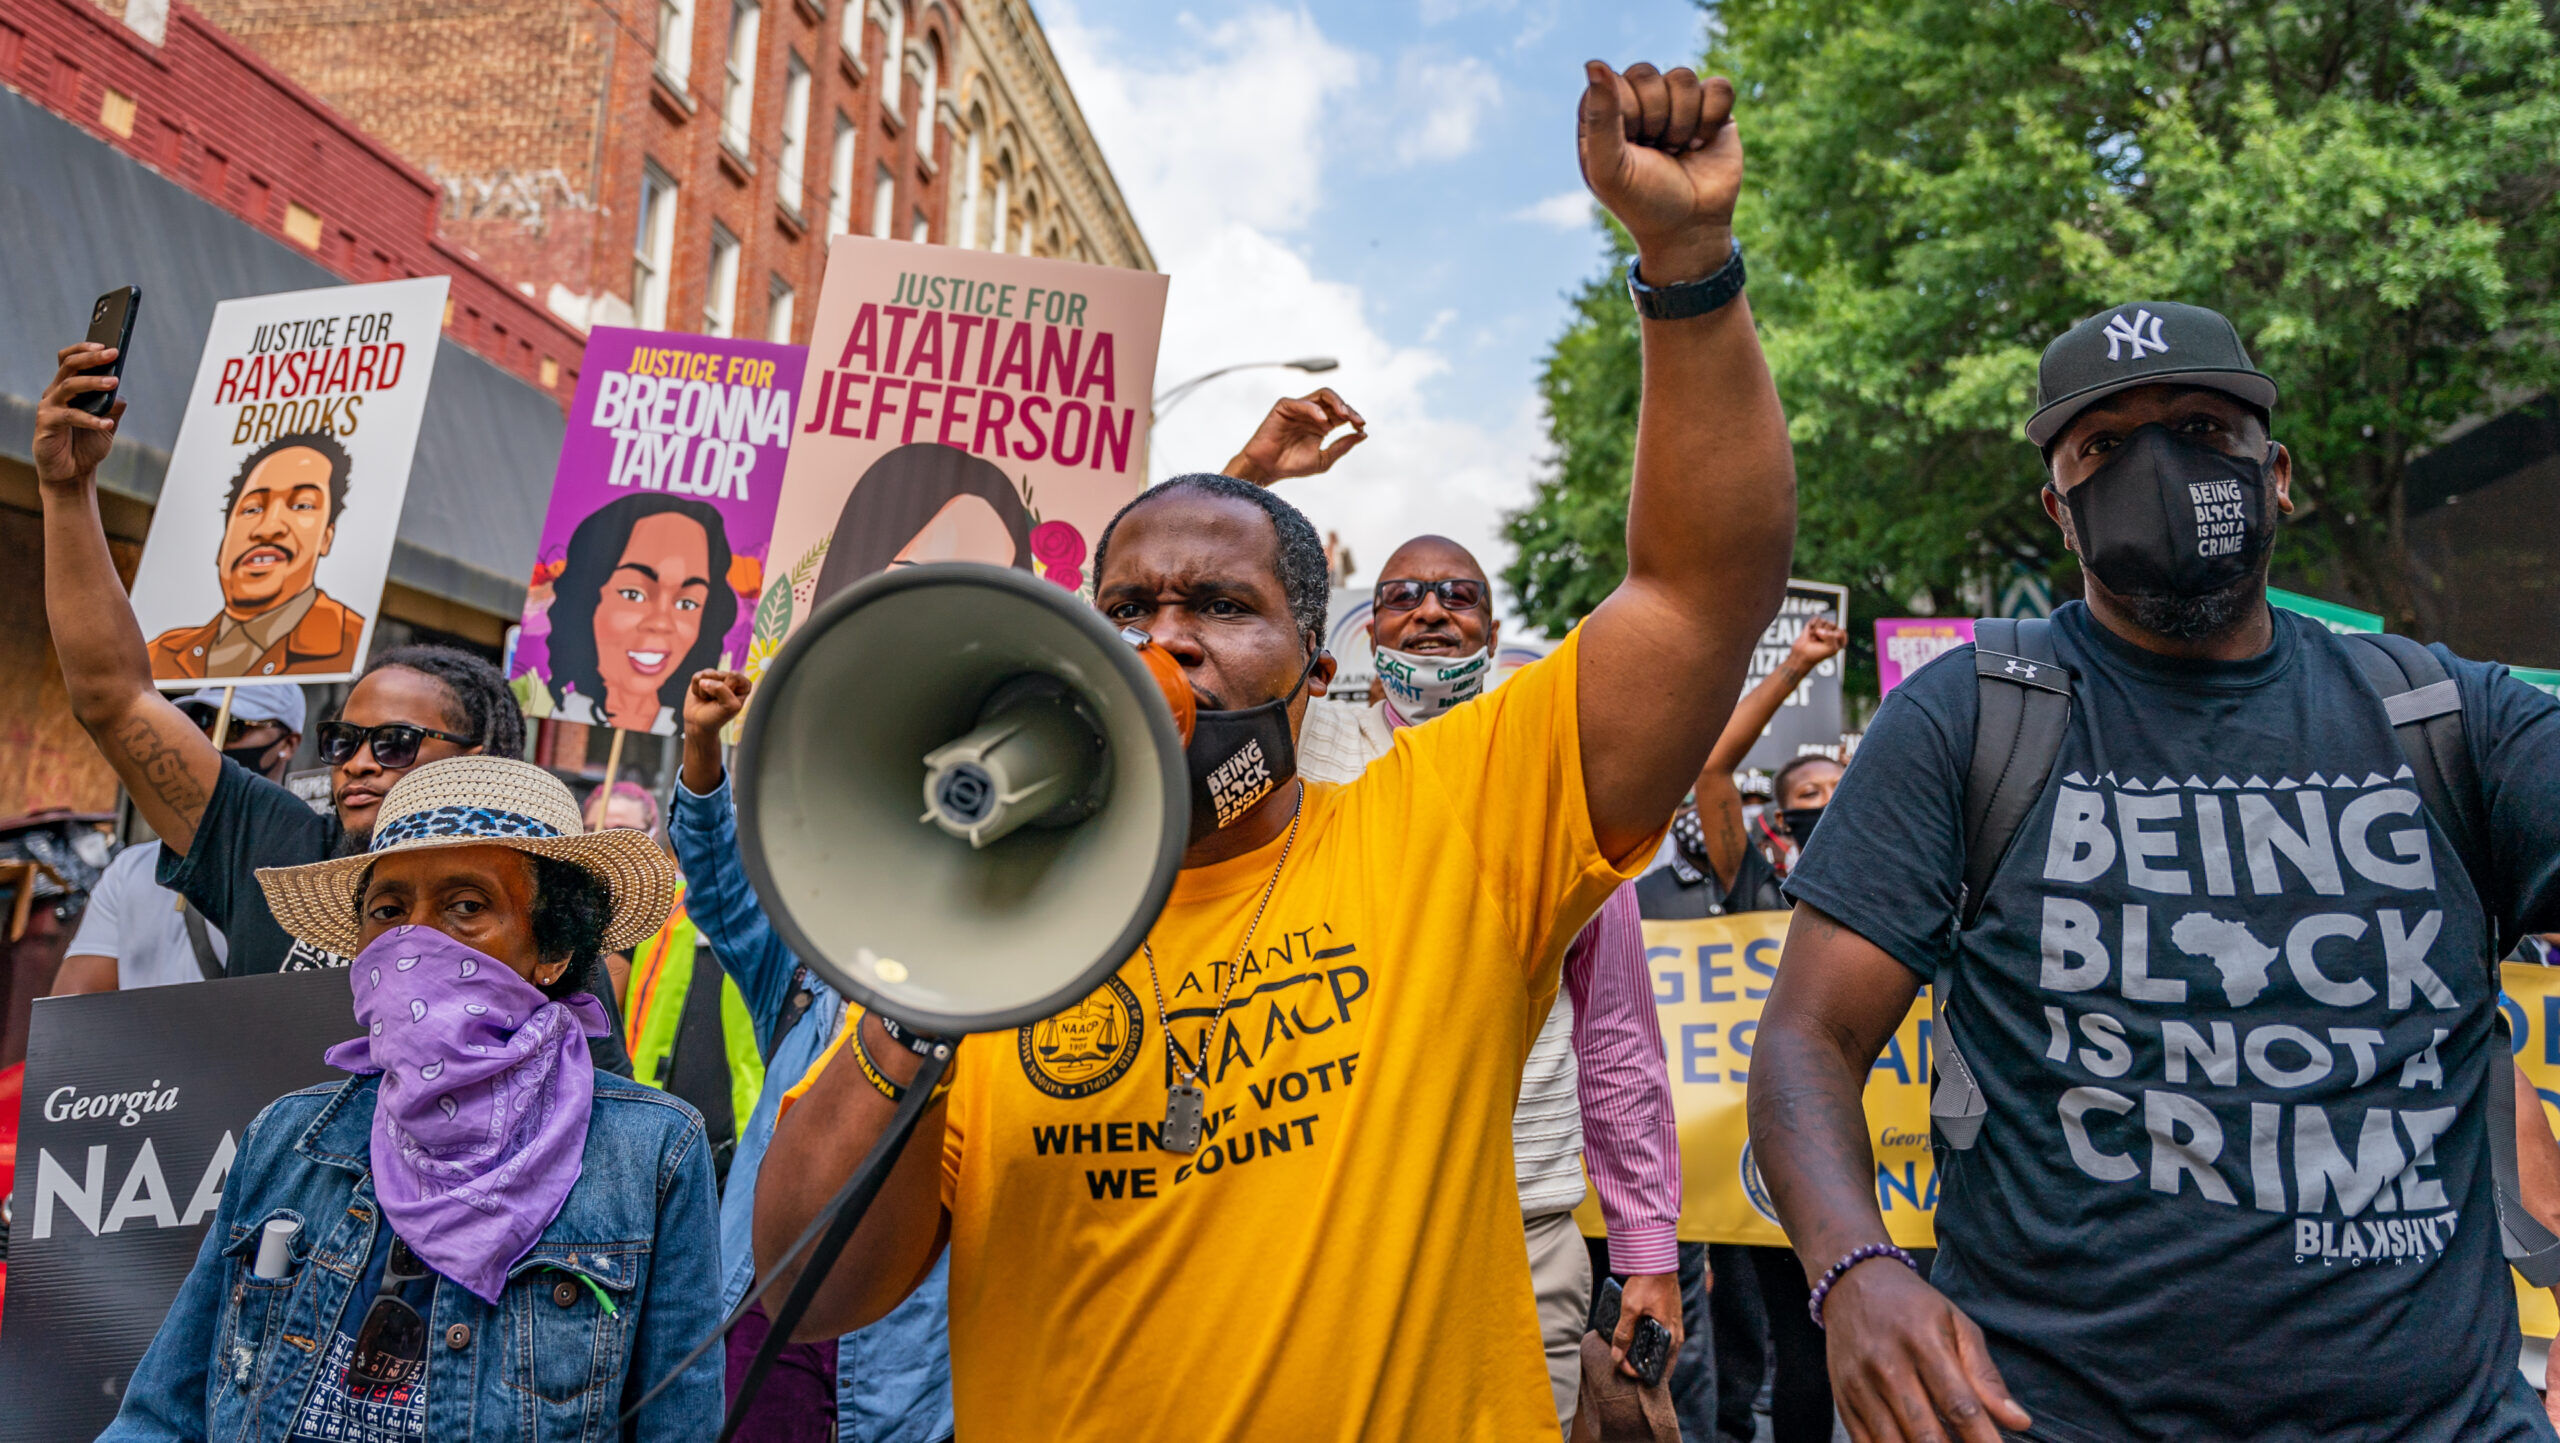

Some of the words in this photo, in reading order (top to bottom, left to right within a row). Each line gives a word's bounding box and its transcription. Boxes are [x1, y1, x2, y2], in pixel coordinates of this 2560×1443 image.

[892, 272, 1016, 318] JUSTICE
[1024, 288, 1088, 327] FOR
[248, 317, 341, 355] JUSTICE
[343, 312, 393, 346] FOR
[838, 302, 1116, 403] ATATIANA
[2102, 309, 2169, 362] NY
[215, 342, 406, 405] RAYSHARD
[627, 346, 723, 383] JUSTICE
[726, 356, 776, 389] FOR
[232, 395, 363, 446] BROOKS
[591, 370, 791, 449] BREONNA
[804, 370, 1135, 474] JEFFERSON
[608, 427, 757, 502] TAYLOR
[2189, 483, 2242, 505] BEING
[2197, 524, 2209, 538] IS
[2211, 521, 2236, 536] NOT
[2236, 520, 2245, 534] A
[2198, 534, 2244, 558] CRIME
[1375, 651, 1417, 684] EAST
[1206, 742, 1264, 797] BEING
[1216, 805, 1231, 820] IS
[1232, 784, 1260, 810] NOT
[2042, 784, 2436, 896] BEING
[1174, 921, 1333, 998] ATLANT
[1107, 974, 1136, 1007] CEMENT
[1060, 1020, 1099, 1035] NAACP
[1130, 1008, 1141, 1021] OF
[1164, 965, 1370, 1090] NAACP
[1021, 1025, 1034, 1063] ASSOCI
[1118, 1023, 1141, 1070] COLORED
[2044, 1005, 2133, 1079] IS
[2160, 1020, 2385, 1089] NOT
[2398, 1028, 2449, 1090] A
[44, 1078, 180, 1127] Georgia
[1081, 1069, 1119, 1095] PEOPLE
[1033, 1121, 1166, 1156] WHEN
[1086, 1167, 1158, 1200] WE
[1174, 1114, 1320, 1185] COUNT
[2057, 1086, 2458, 1217] CRIME
[313, 1393, 325, 1406] Re
[367, 1412, 379, 1423] Pt
[386, 1417, 401, 1427] Au
[408, 1420, 423, 1433] Hg
[392, 1390, 409, 1402] Sm
[304, 1420, 318, 1432] Bh
[326, 1423, 340, 1436] Hs
[347, 1427, 362, 1438] Mt
